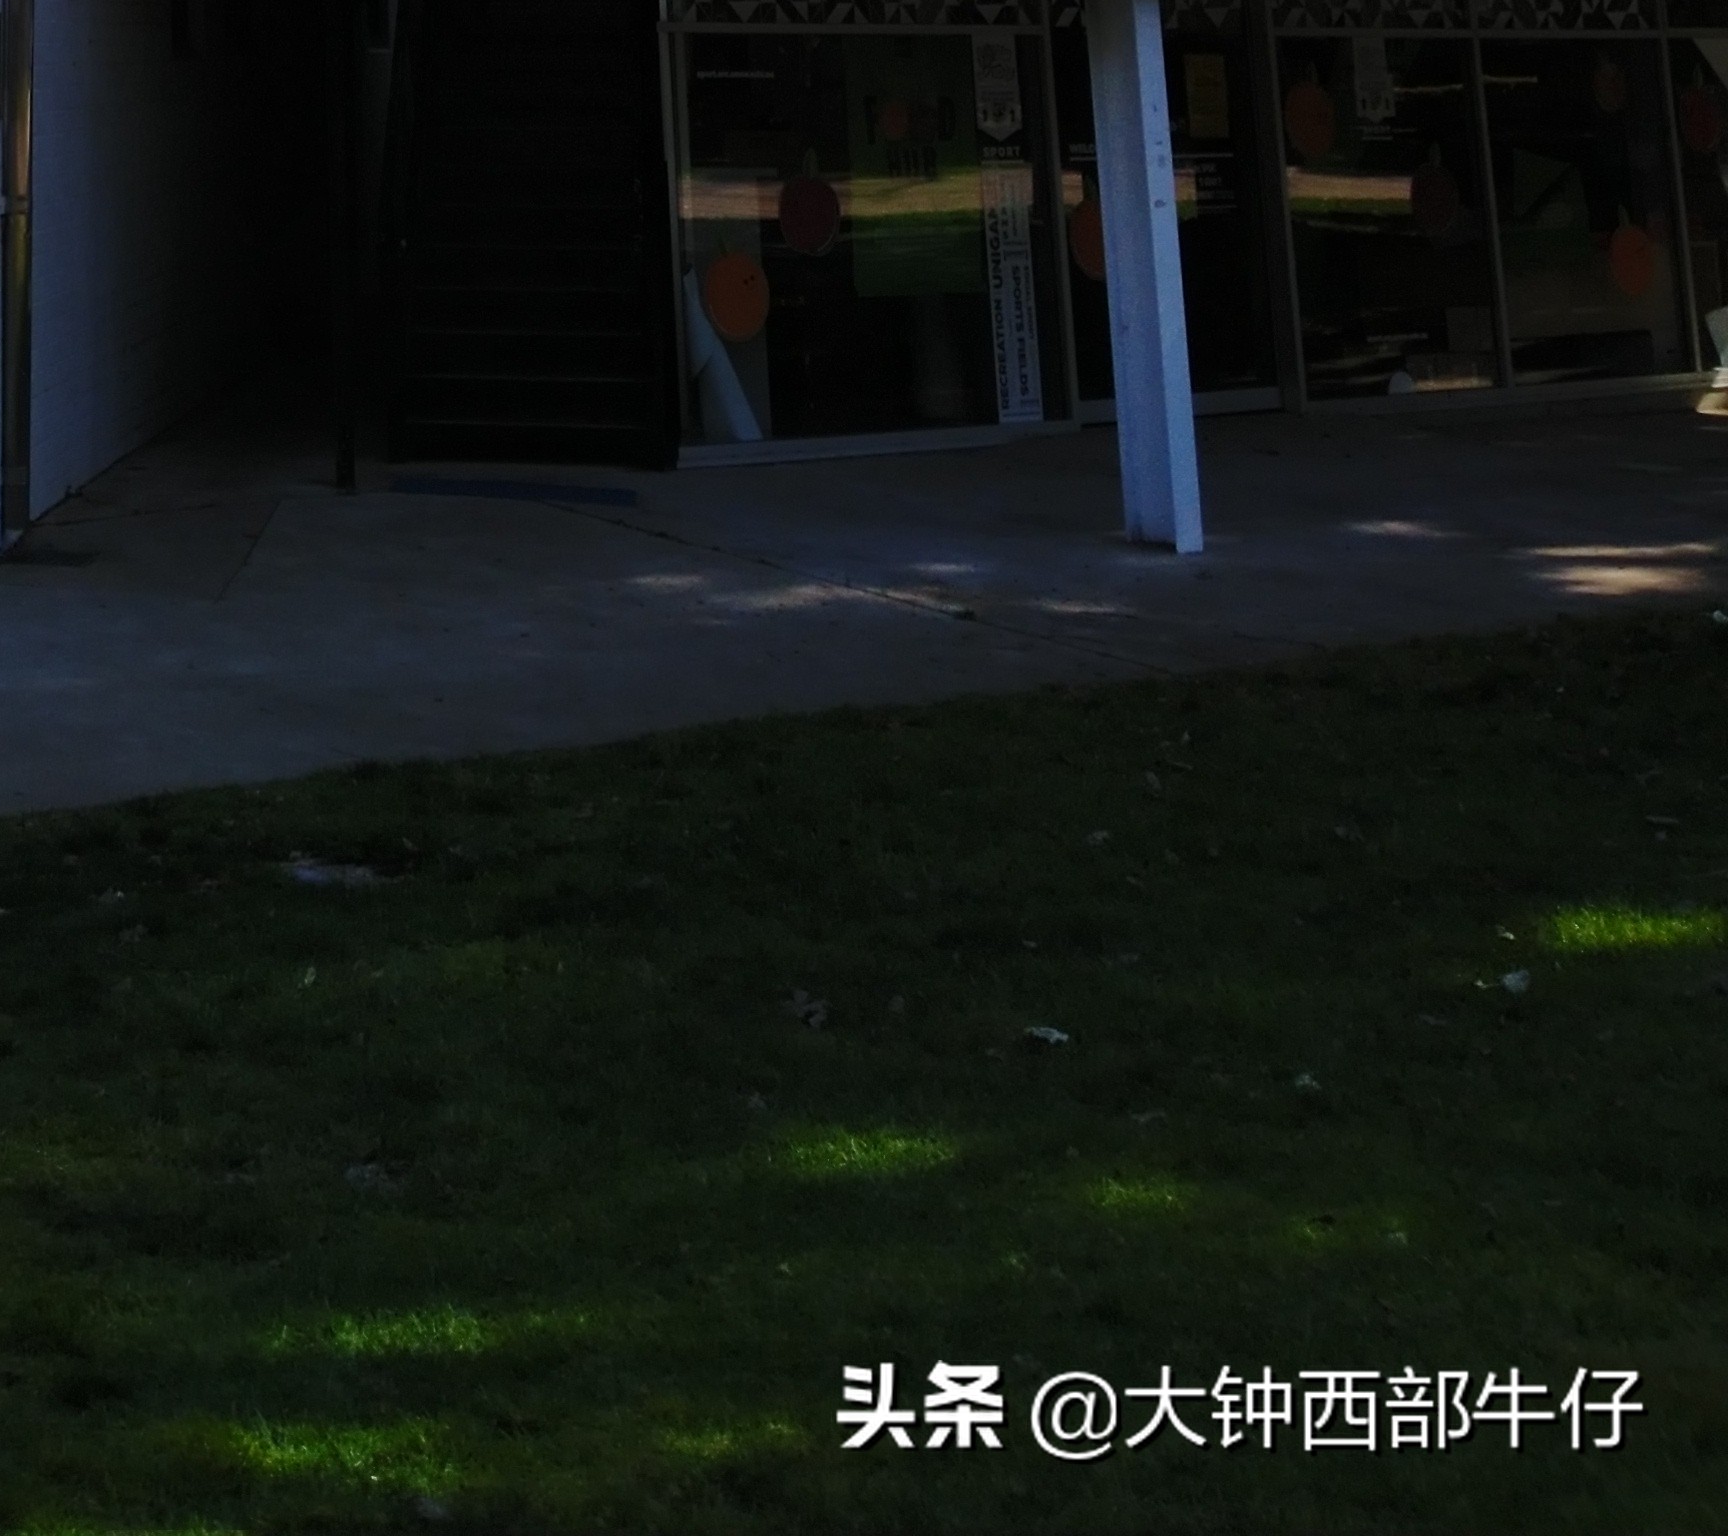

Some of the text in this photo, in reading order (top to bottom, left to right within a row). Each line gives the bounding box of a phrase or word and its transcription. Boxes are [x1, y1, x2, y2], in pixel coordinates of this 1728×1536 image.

[982, 146, 1021, 158] SPORT
[994, 299, 1010, 410] RECREATION
[1012, 264, 1029, 397] SPORTS FIELDS
